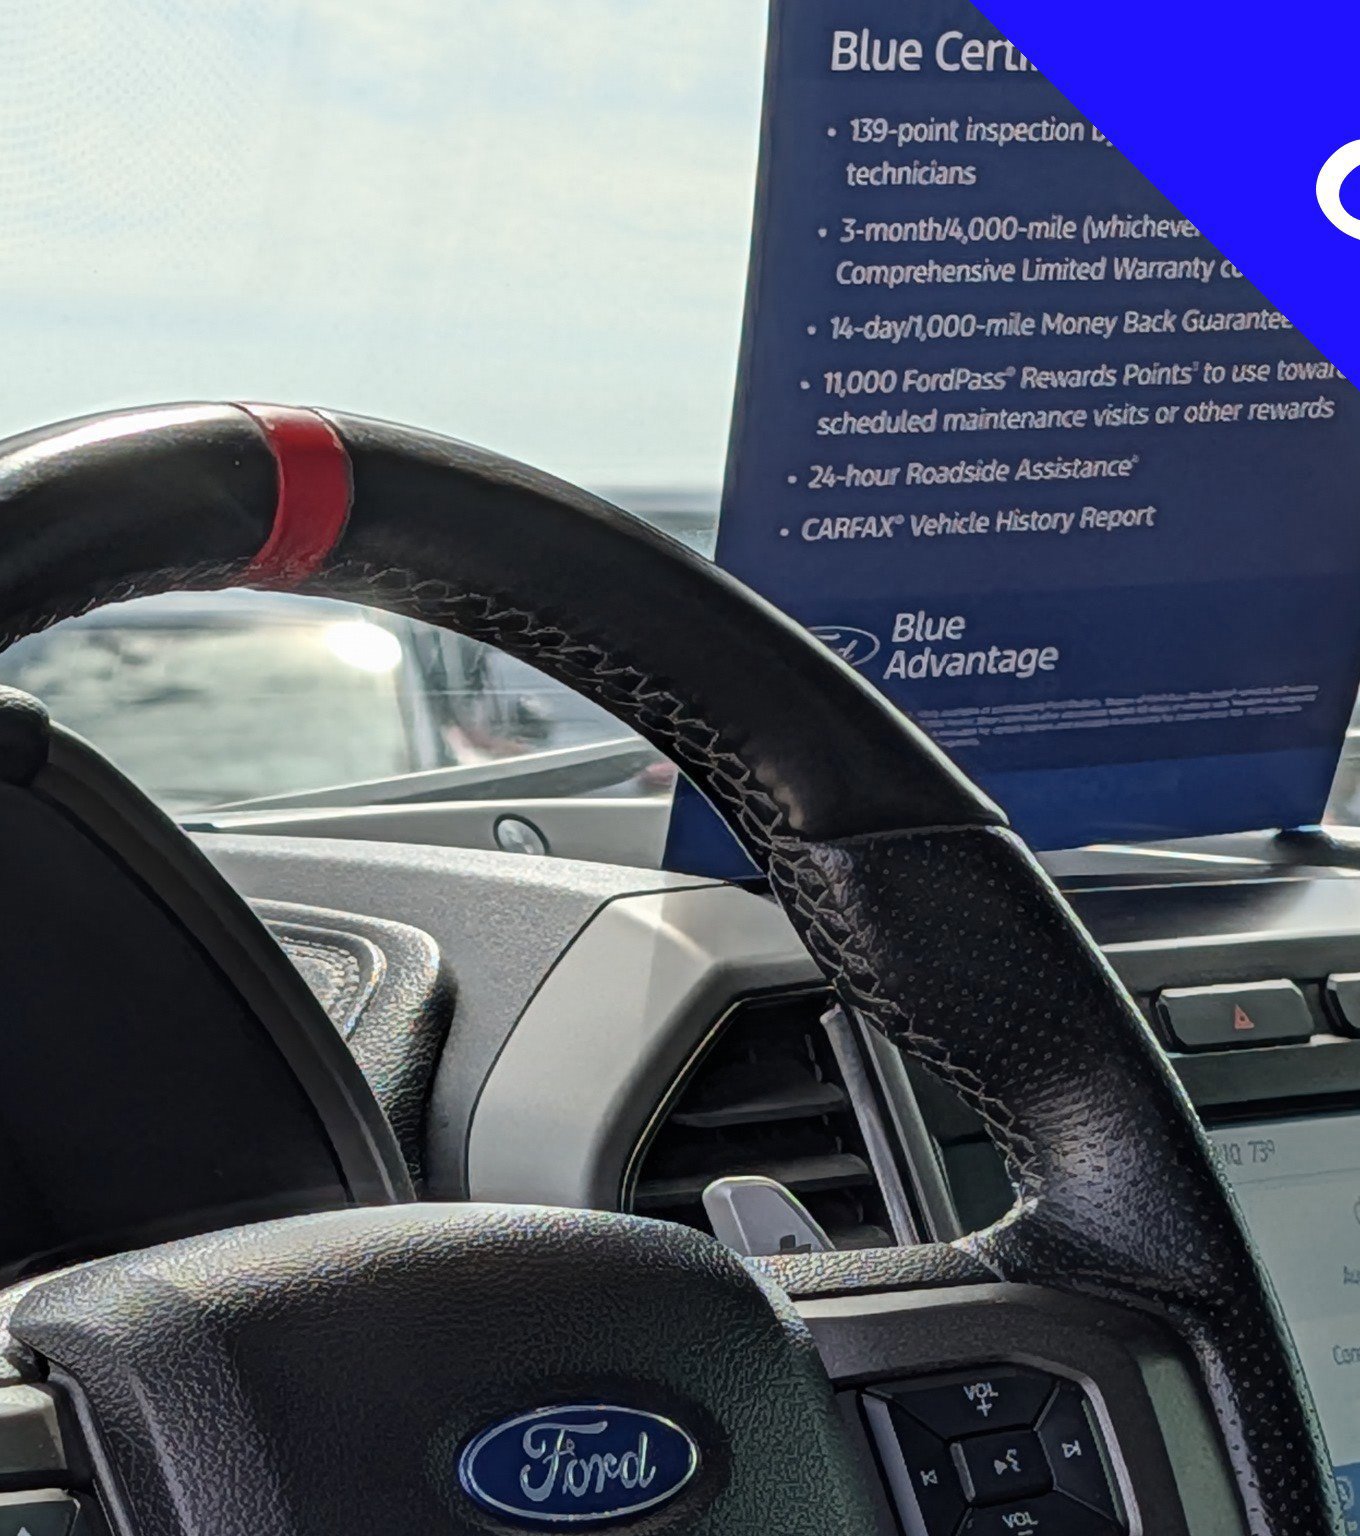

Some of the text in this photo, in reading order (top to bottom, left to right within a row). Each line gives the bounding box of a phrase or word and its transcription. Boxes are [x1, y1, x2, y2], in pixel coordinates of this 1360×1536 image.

[830, 28, 923, 72] Blue
[850, 117, 958, 147] 139-point
[966, 116, 1084, 147] inspection
[846, 160, 977, 186] technicians
[840, 213, 1077, 245] 3-month/4,000-mile
[836, 258, 1016, 289] Comprehensive
[1022, 257, 1106, 281] Limited
[1113, 256, 1216, 283] Warranty
[830, 308, 1293, 344] 14-day/1,000-mile Money Back Guarantee
[824, 370, 897, 398] 11,000
[1020, 364, 1117, 389] Rewards
[1203, 363, 1226, 384] to
[1231, 363, 1271, 384] use
[817, 396, 1335, 436] scheduled maintenance visits or other rewards
[808, 464, 901, 490] 24-hour
[905, 458, 1011, 486] Roadside
[910, 510, 990, 537] Vehicle
[996, 508, 1076, 535] History
[1079, 505, 1157, 532] Report
[891, 610, 966, 644] Blue
[883, 645, 1060, 681] Advantage
[963, 1382, 999, 1402] VOL
[520, 1420, 657, 1502] Ford
[1002, 1511, 1038, 1530] VOL
